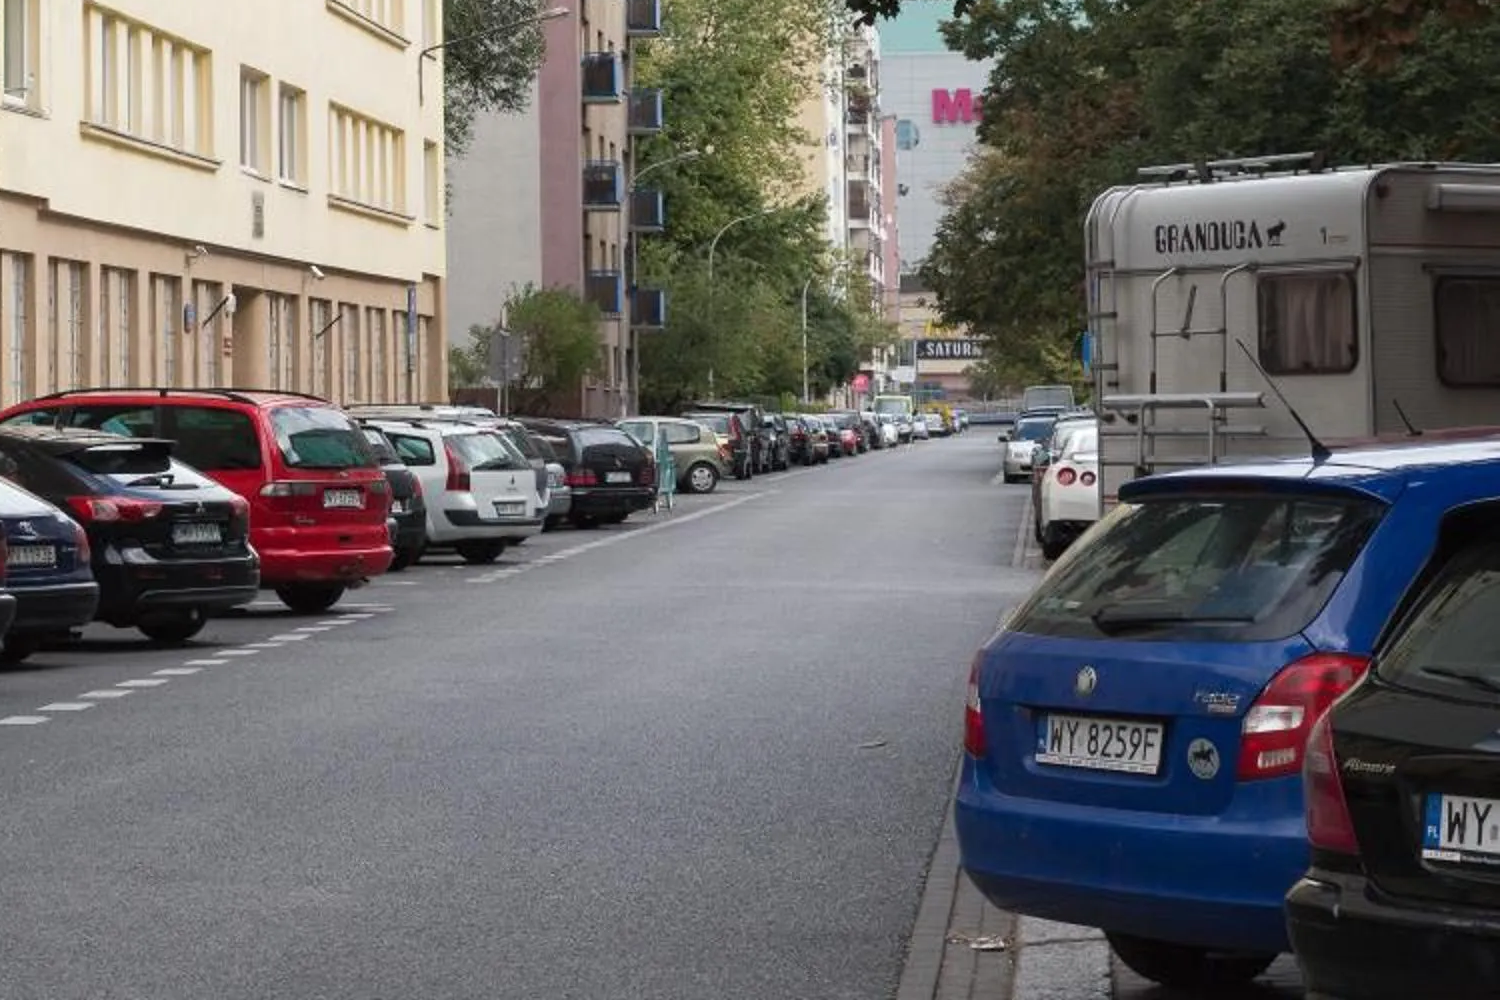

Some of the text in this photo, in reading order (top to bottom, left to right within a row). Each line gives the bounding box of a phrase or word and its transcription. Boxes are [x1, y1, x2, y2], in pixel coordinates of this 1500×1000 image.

[1050, 719, 1160, 762] WY 8259F
[1426, 801, 1493, 846] PL WY
